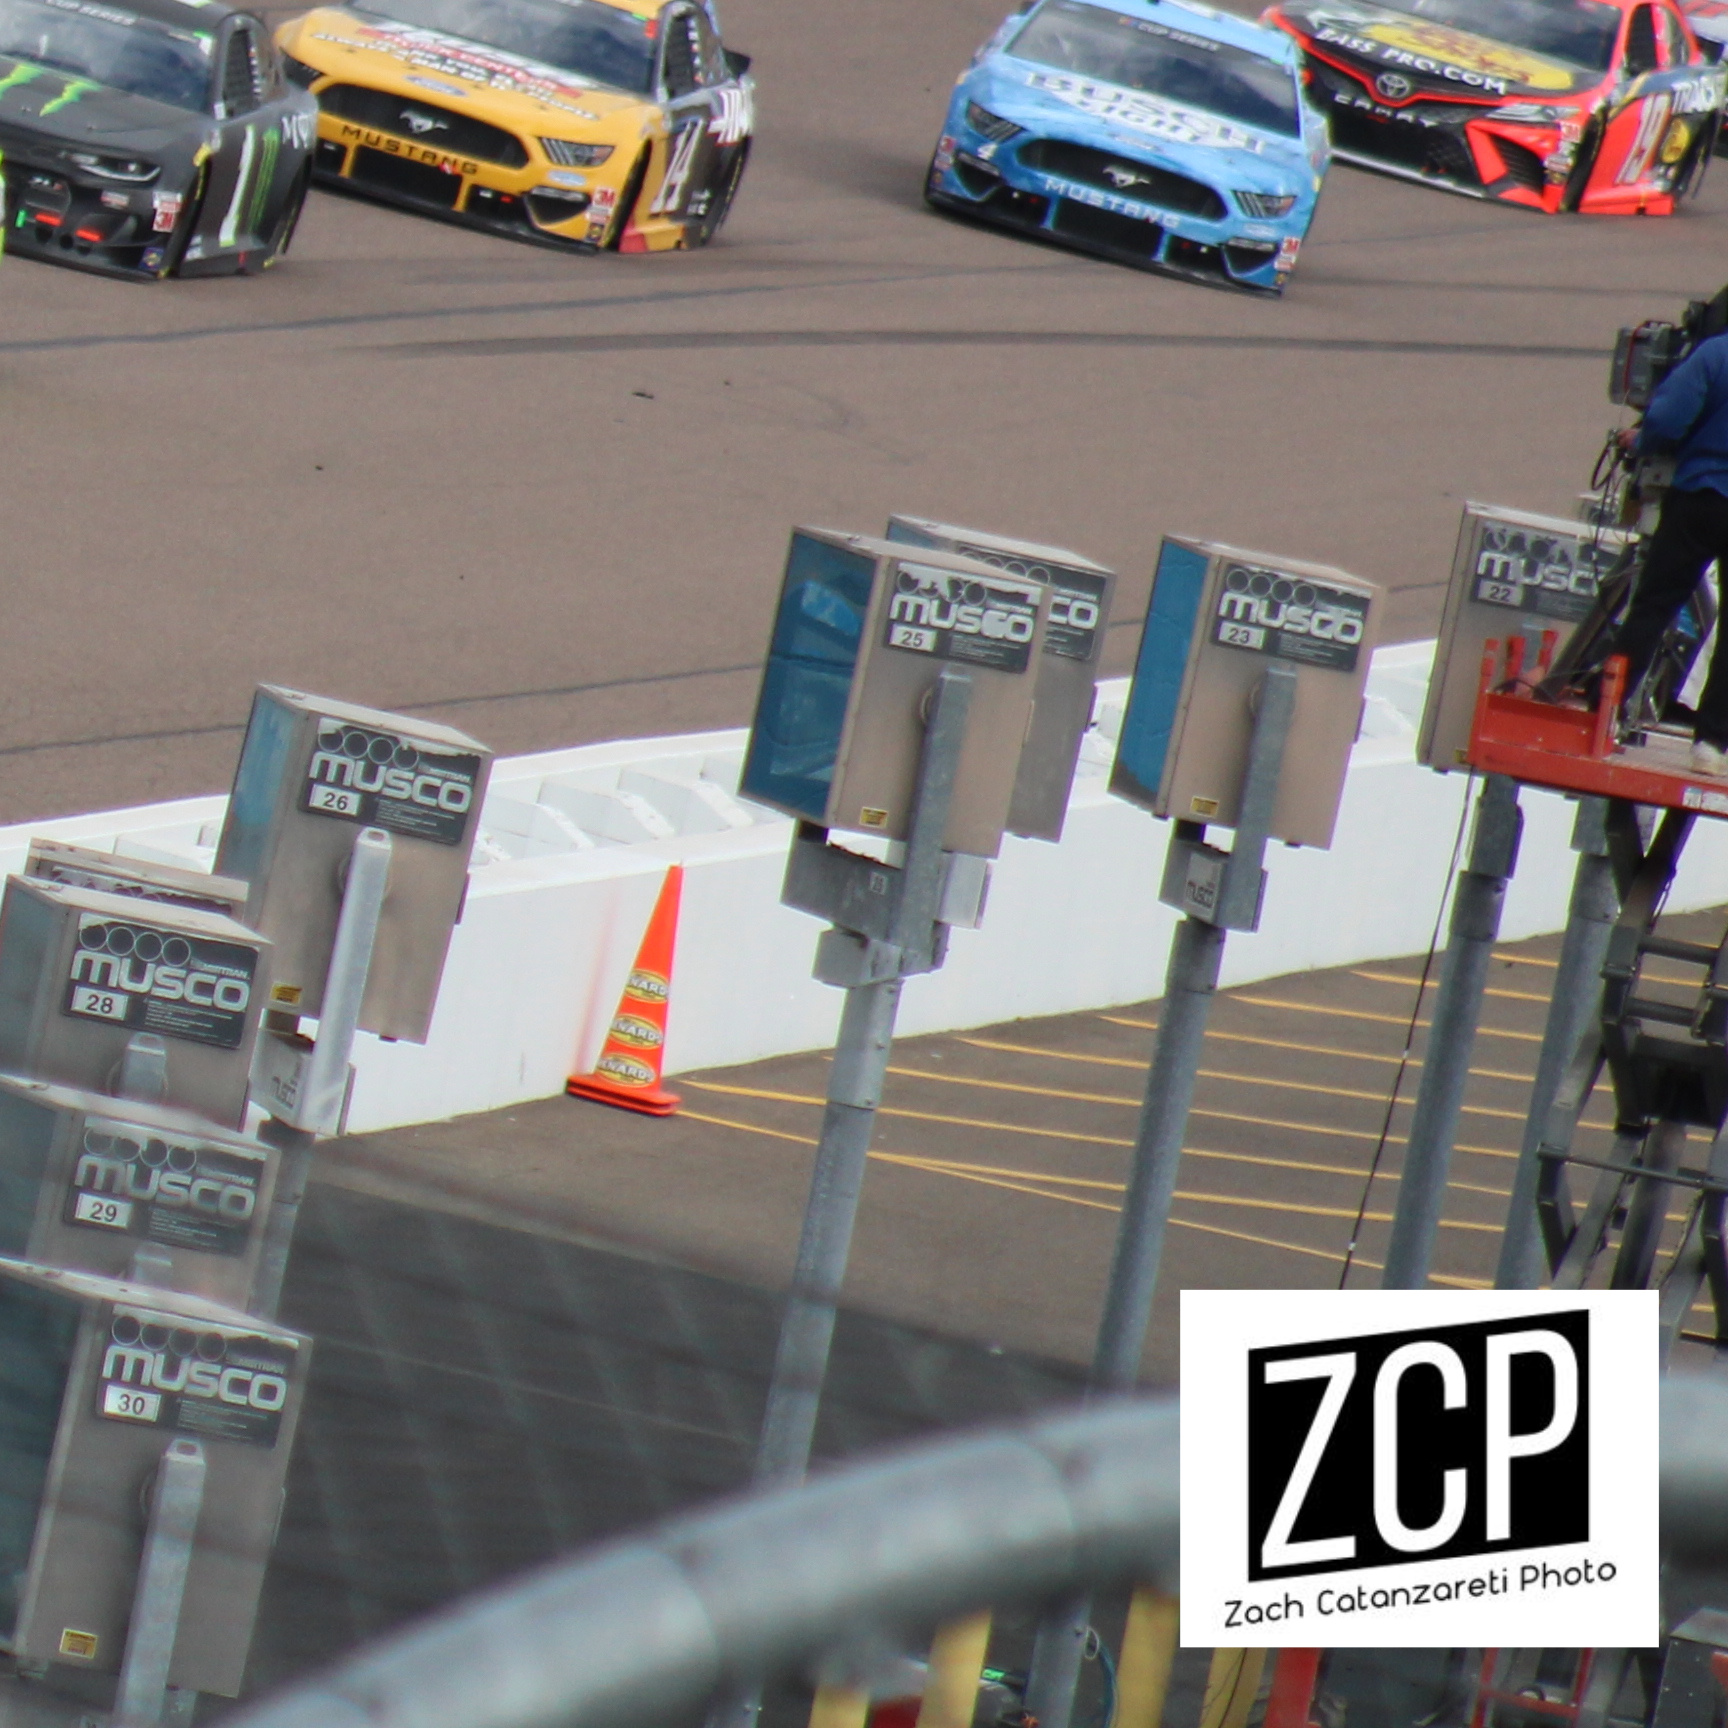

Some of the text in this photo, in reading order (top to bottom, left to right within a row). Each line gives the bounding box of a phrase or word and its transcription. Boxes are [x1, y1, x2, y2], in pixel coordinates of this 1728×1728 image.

[77, 3, 138, 27] SERIES
[1314, 27, 1377, 54] BASS
[341, 124, 479, 175] MUSTANG
[976, 141, 999, 160] 4
[648, 117, 705, 215] 14
[1043, 177, 1182, 229] MUSTANG
[1488, 585, 1512, 603] 22
[900, 629, 924, 649] 25
[1227, 626, 1251, 645] 23
[322, 791, 349, 812] 26
[84, 992, 114, 1015] 28
[89, 1201, 118, 1223] 29
[116, 1393, 146, 1416] 30
